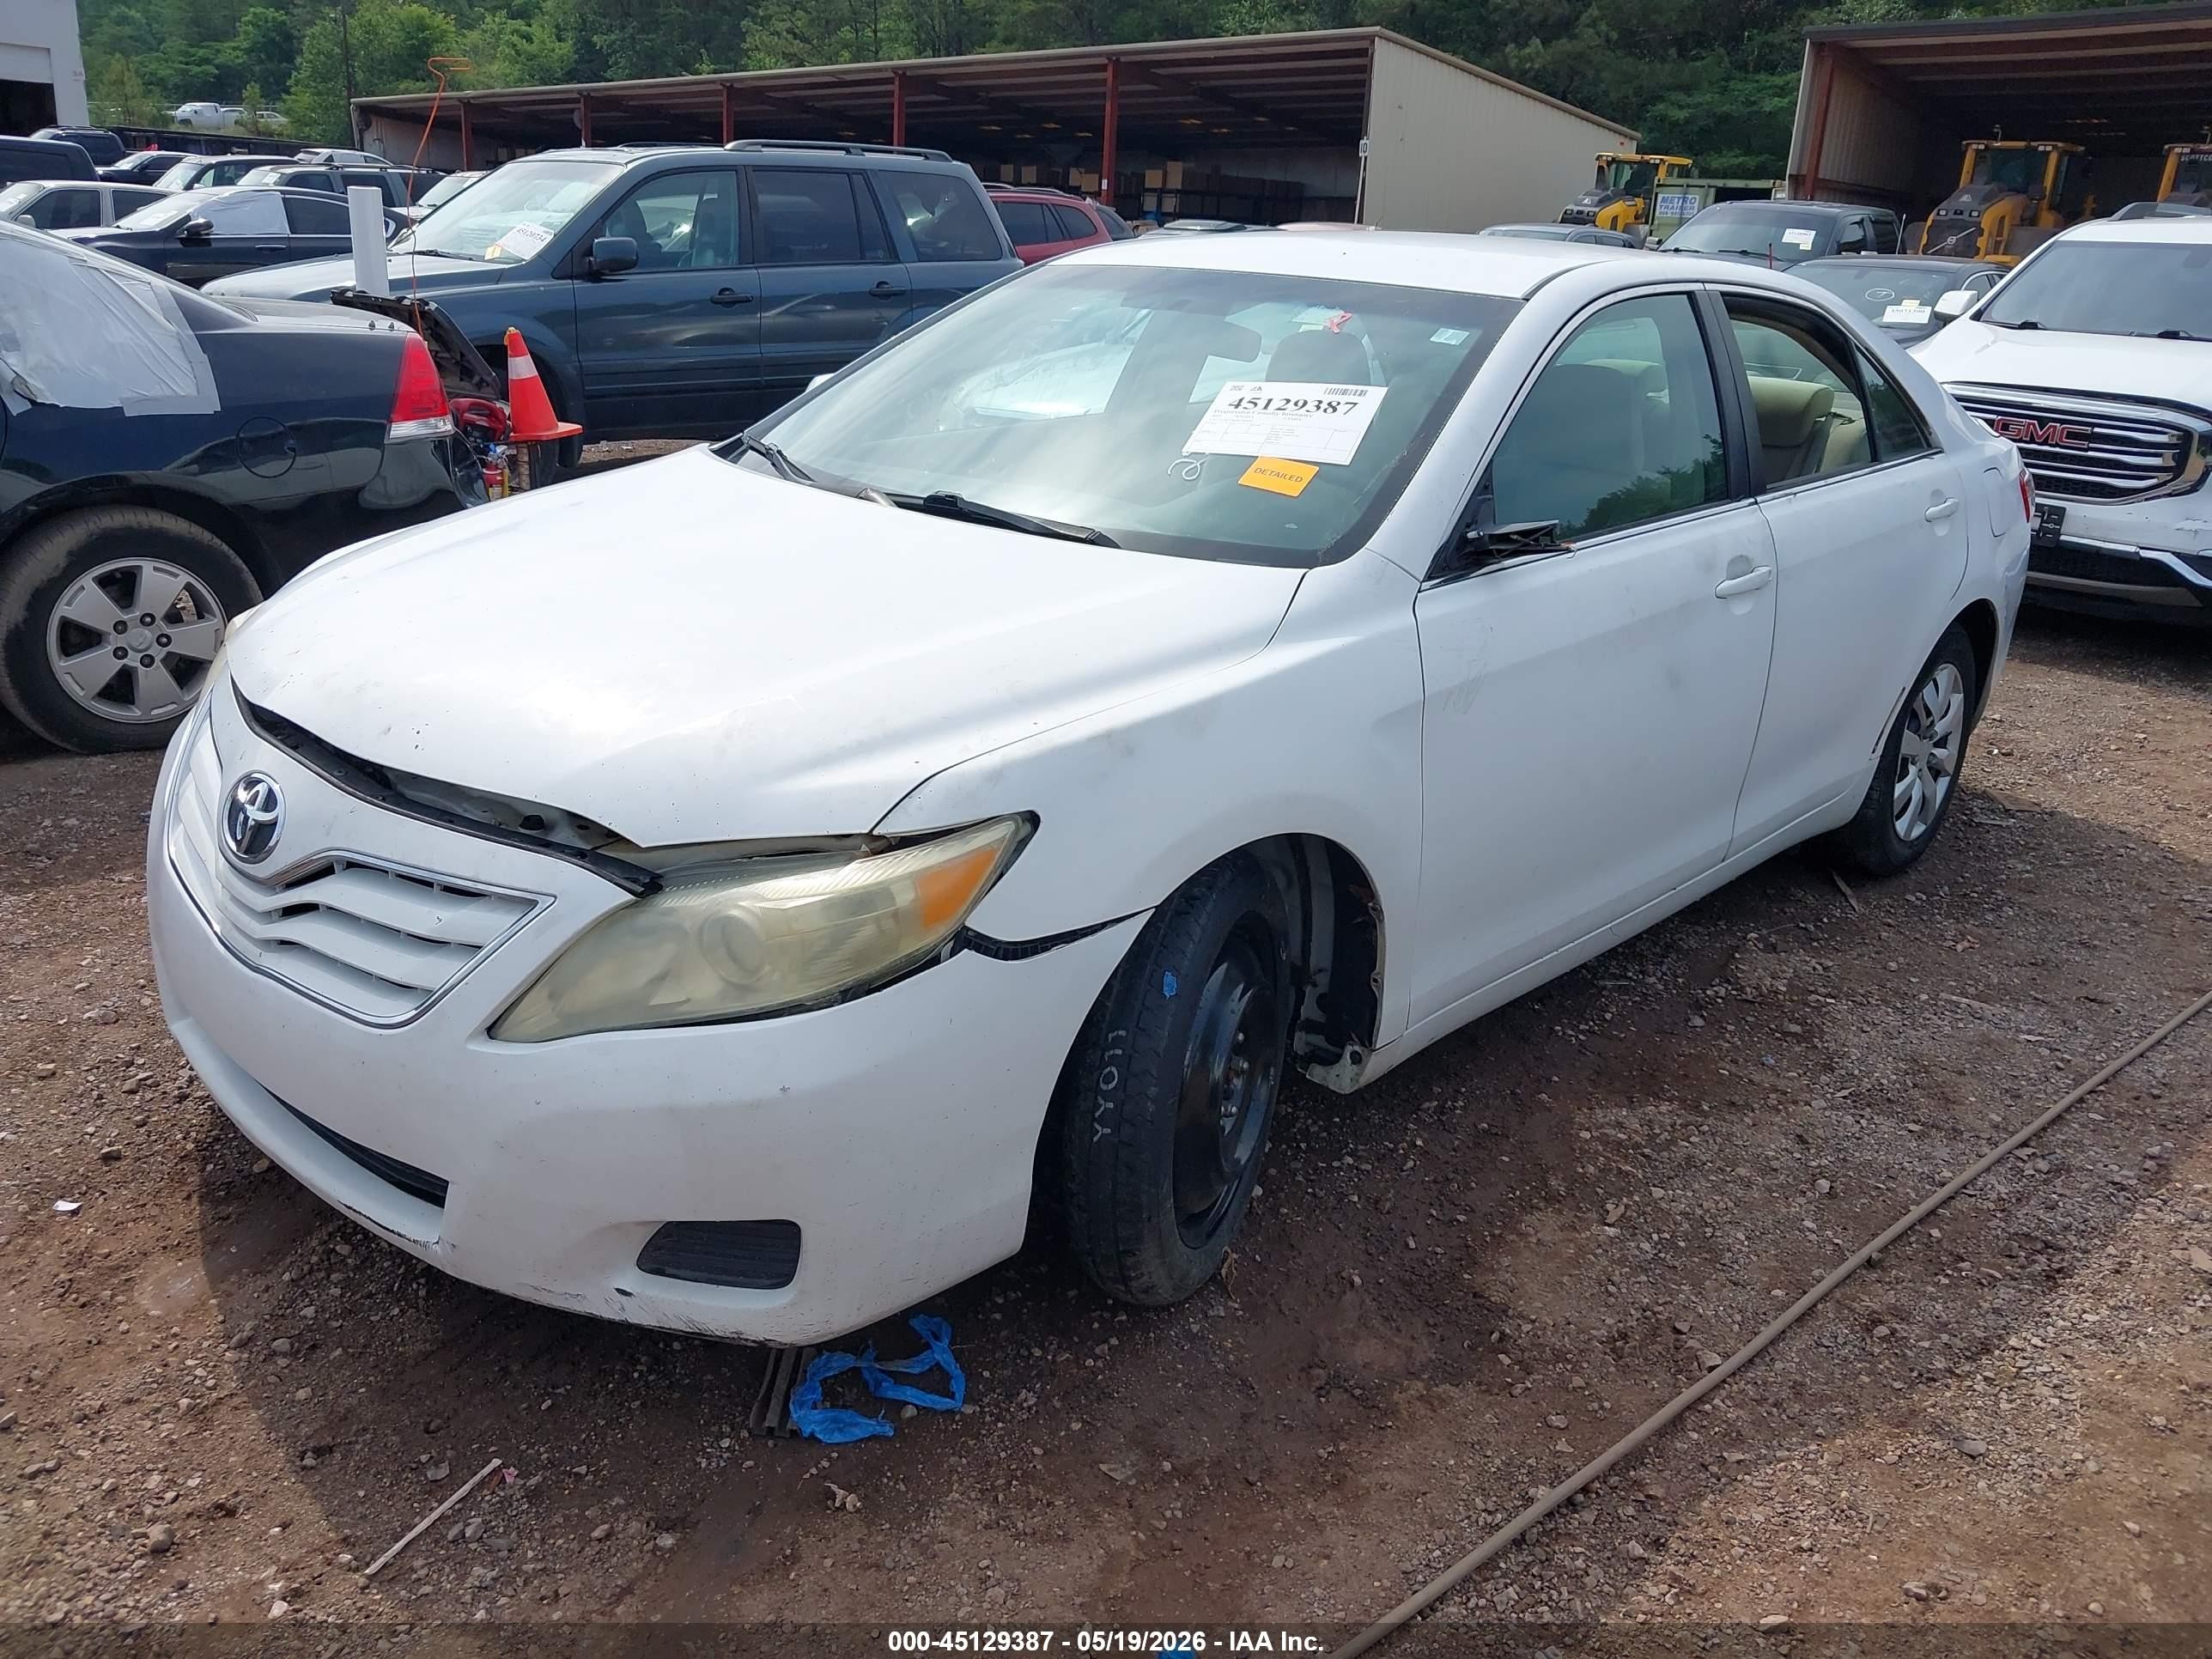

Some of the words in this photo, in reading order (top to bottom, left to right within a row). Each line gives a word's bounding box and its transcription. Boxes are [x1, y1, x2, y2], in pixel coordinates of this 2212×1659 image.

[1660, 195, 1697, 205] METRO
[1227, 396, 1359, 416] 45129387
[1993, 416, 2092, 448] GMC
[1254, 467, 1304, 483] DETAILED
